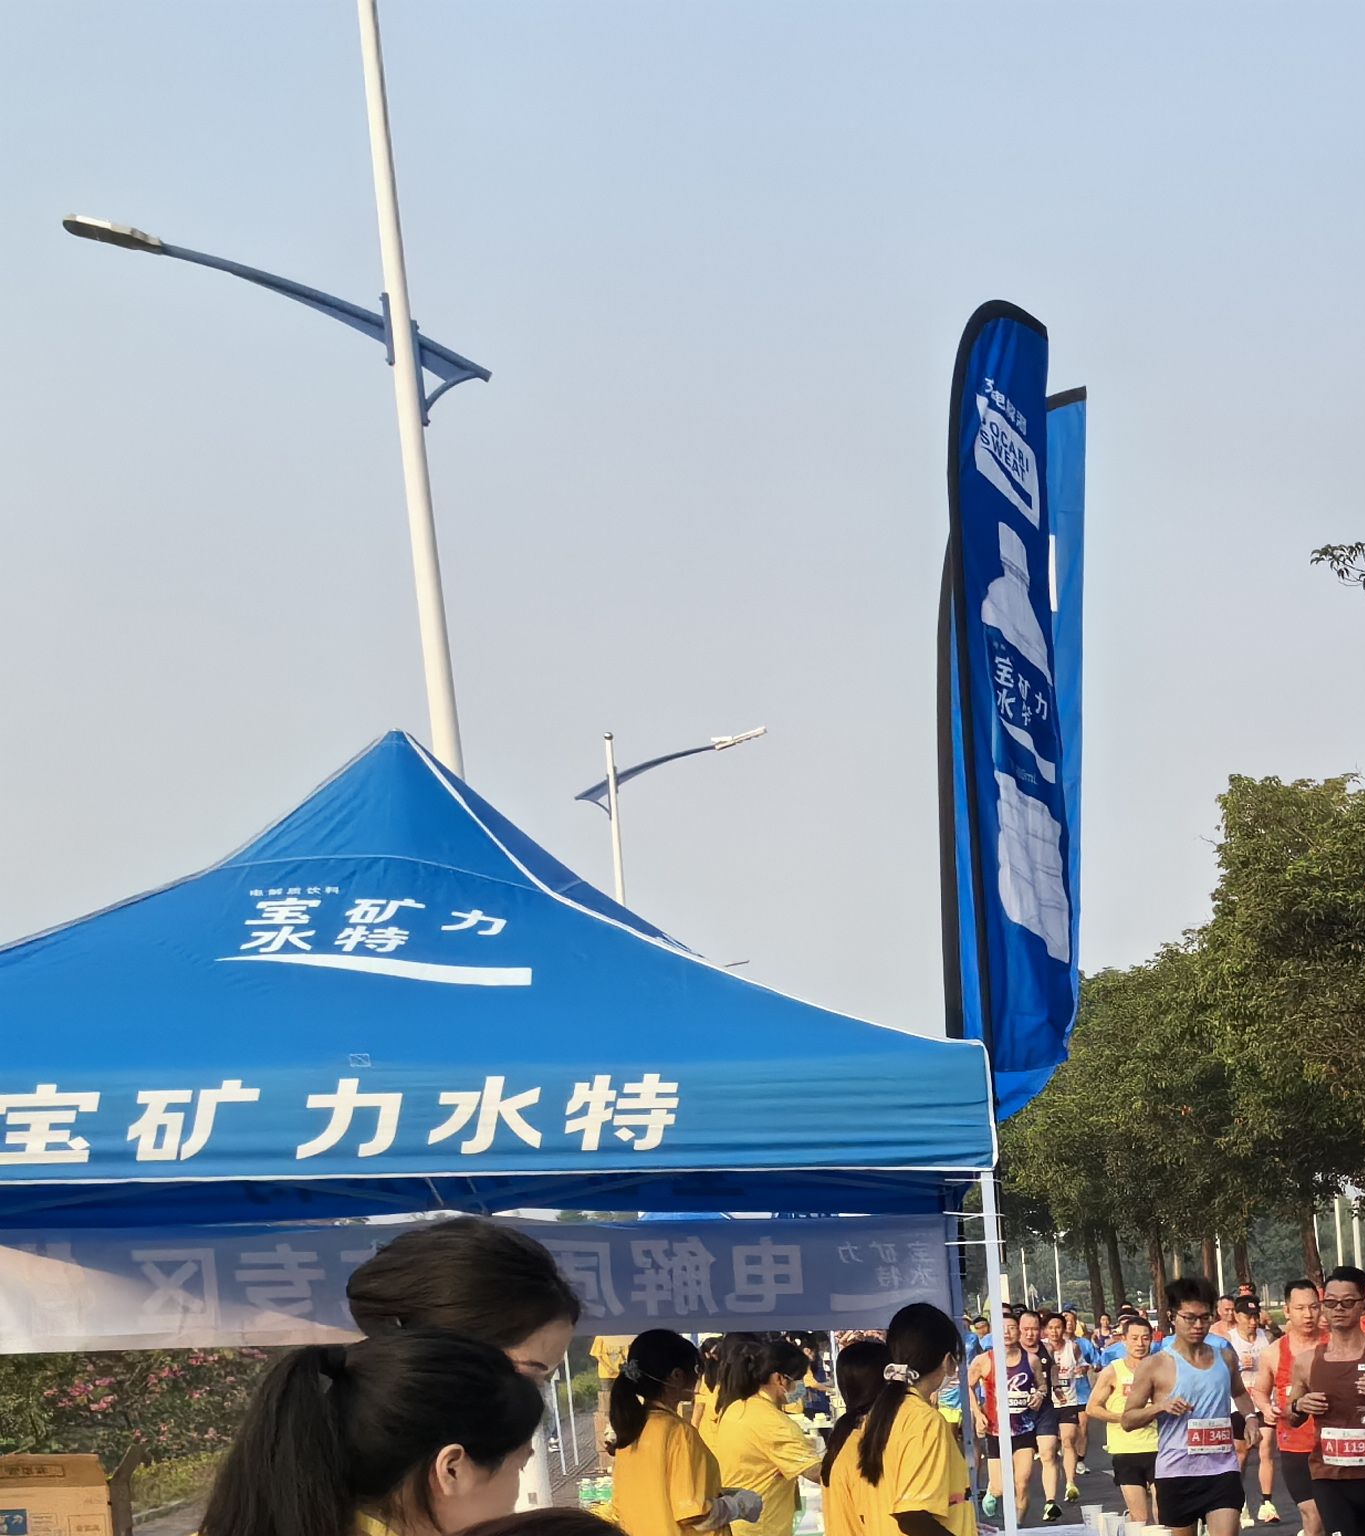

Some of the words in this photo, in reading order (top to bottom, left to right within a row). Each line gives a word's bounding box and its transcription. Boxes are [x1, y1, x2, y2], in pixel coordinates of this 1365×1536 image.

[245, 897, 507, 936] 宝矿力
[240, 926, 410, 953] 水特
[0, 1073, 680, 1165] 宝矿力水特
[1191, 1433, 1200, 1442] A
[1324, 1442, 1334, 1453] A
